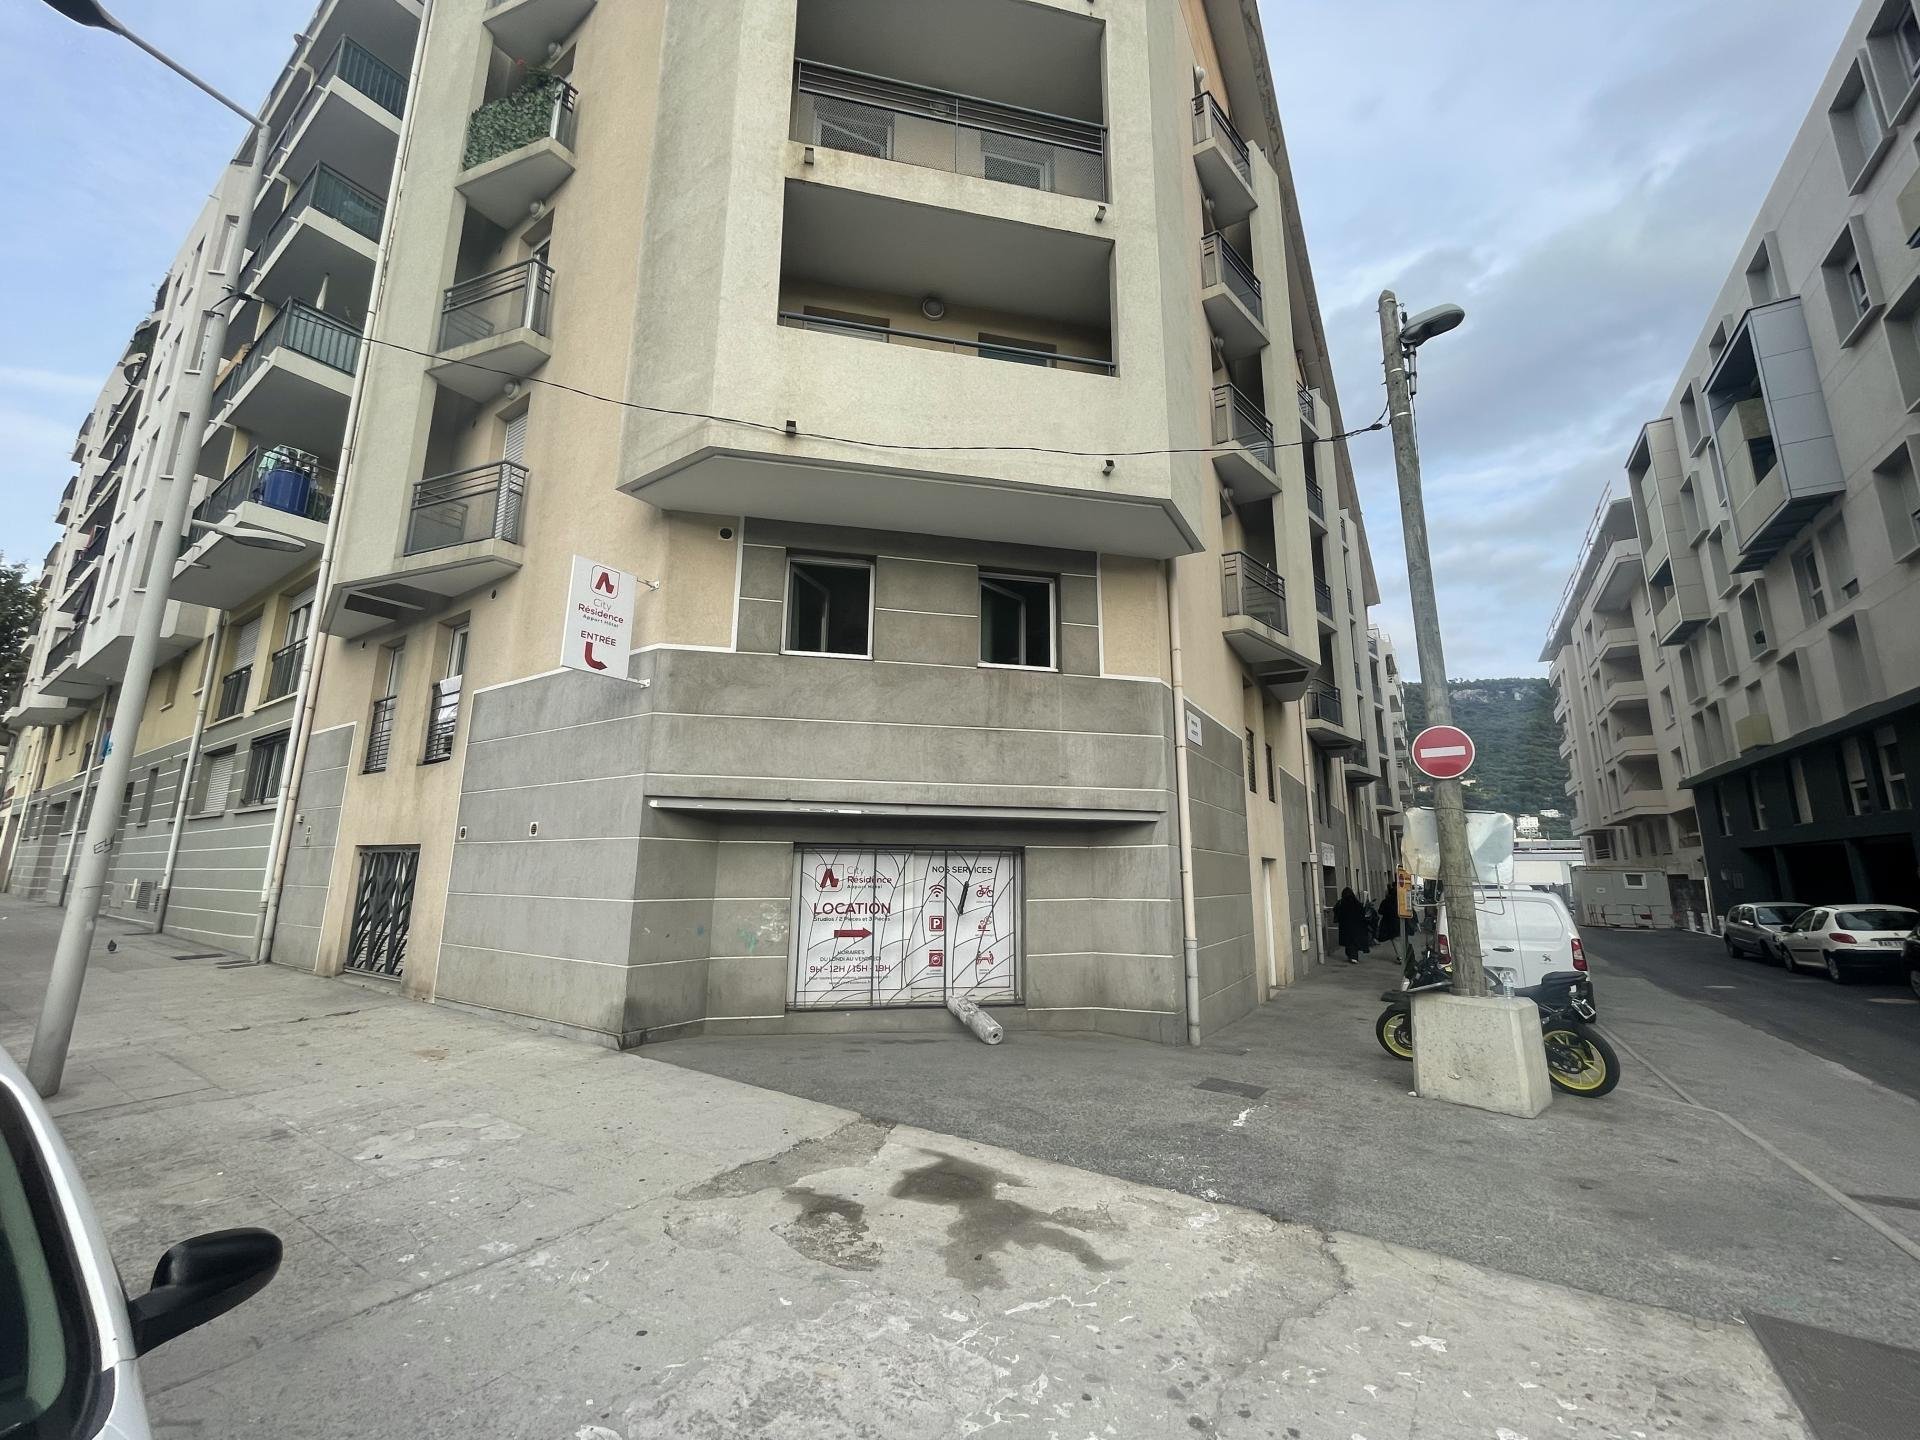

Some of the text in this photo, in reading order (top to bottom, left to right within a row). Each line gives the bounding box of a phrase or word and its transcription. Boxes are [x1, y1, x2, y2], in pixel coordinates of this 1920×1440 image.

[593, 598, 612, 611] City
[578, 602, 624, 624] Résidence
[580, 630, 617, 647] ENTRÉE
[847, 876, 893, 884] Résidence
[813, 902, 892, 915] LOCATION
